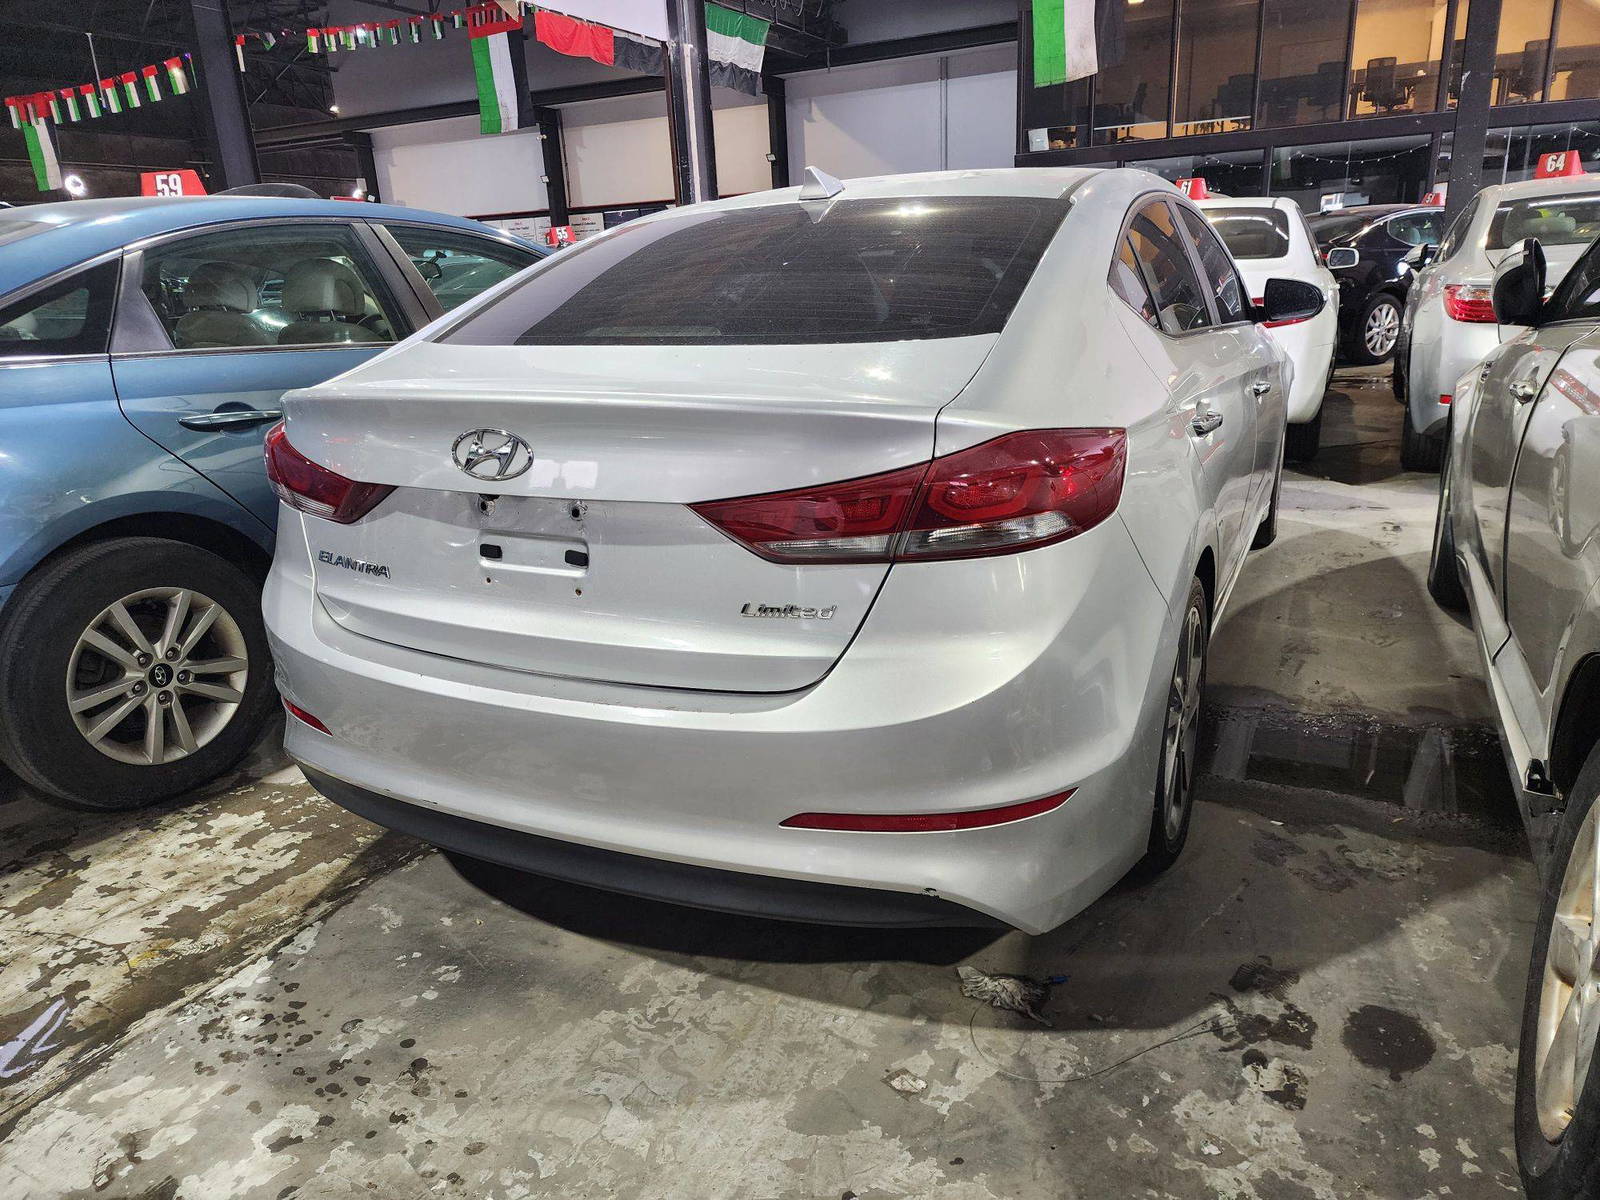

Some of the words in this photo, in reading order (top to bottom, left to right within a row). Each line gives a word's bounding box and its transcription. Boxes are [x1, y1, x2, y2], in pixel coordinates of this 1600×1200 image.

[1546, 153, 1565, 172] 64
[156, 174, 183, 197] 59
[557, 228, 568, 239] 55
[319, 550, 391, 579] ELANTRA
[741, 603, 837, 619] Limited
